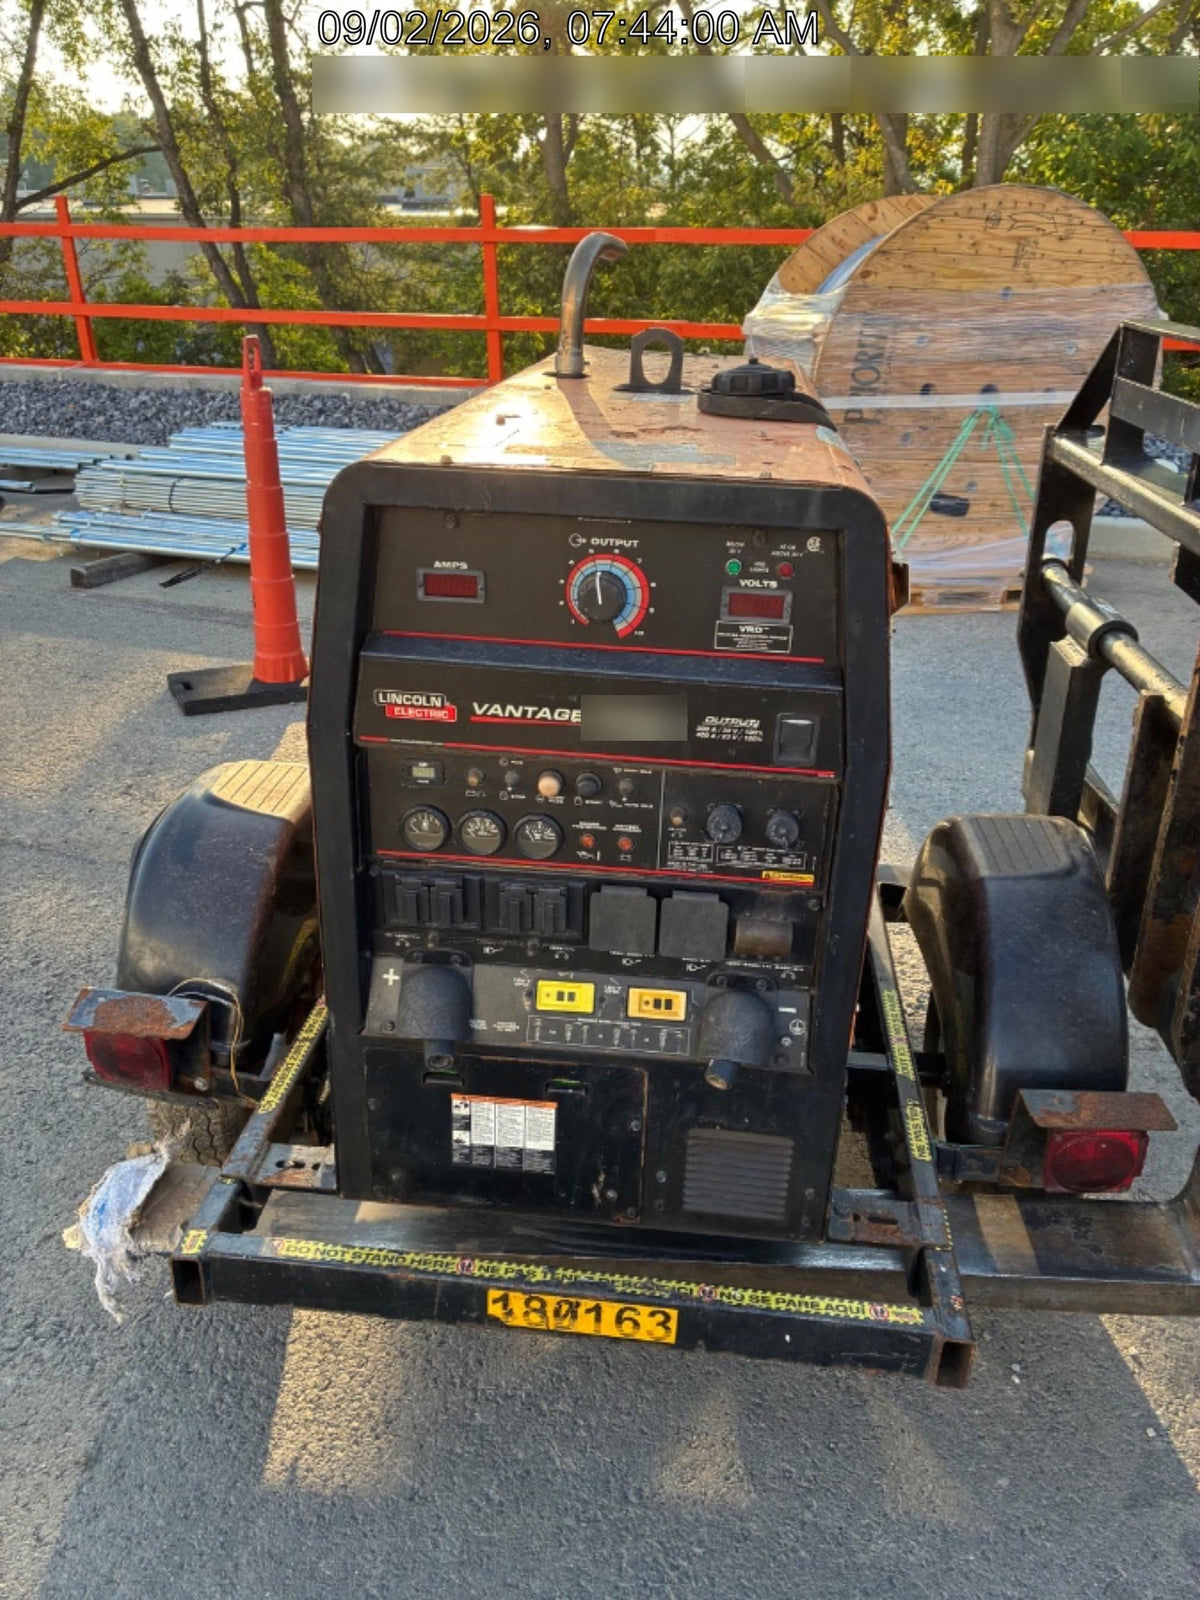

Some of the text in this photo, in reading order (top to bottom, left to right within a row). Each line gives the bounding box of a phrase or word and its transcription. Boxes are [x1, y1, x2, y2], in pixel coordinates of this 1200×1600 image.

[590, 537, 640, 548] OUTPUT
[433, 560, 469, 570] AMPS
[739, 579, 778, 589] VOLTS
[378, 692, 442, 707] LINCOLN
[393, 706, 449, 719] ELECTRIC
[472, 701, 581, 722] VANTAGE
[285, 1245, 455, 1269] DO NOT STAND HERE
[477, 1264, 500, 1274] NE
[719, 1291, 745, 1301] NO
[752, 1295, 772, 1305] SE
[775, 1297, 821, 1310] PARE
